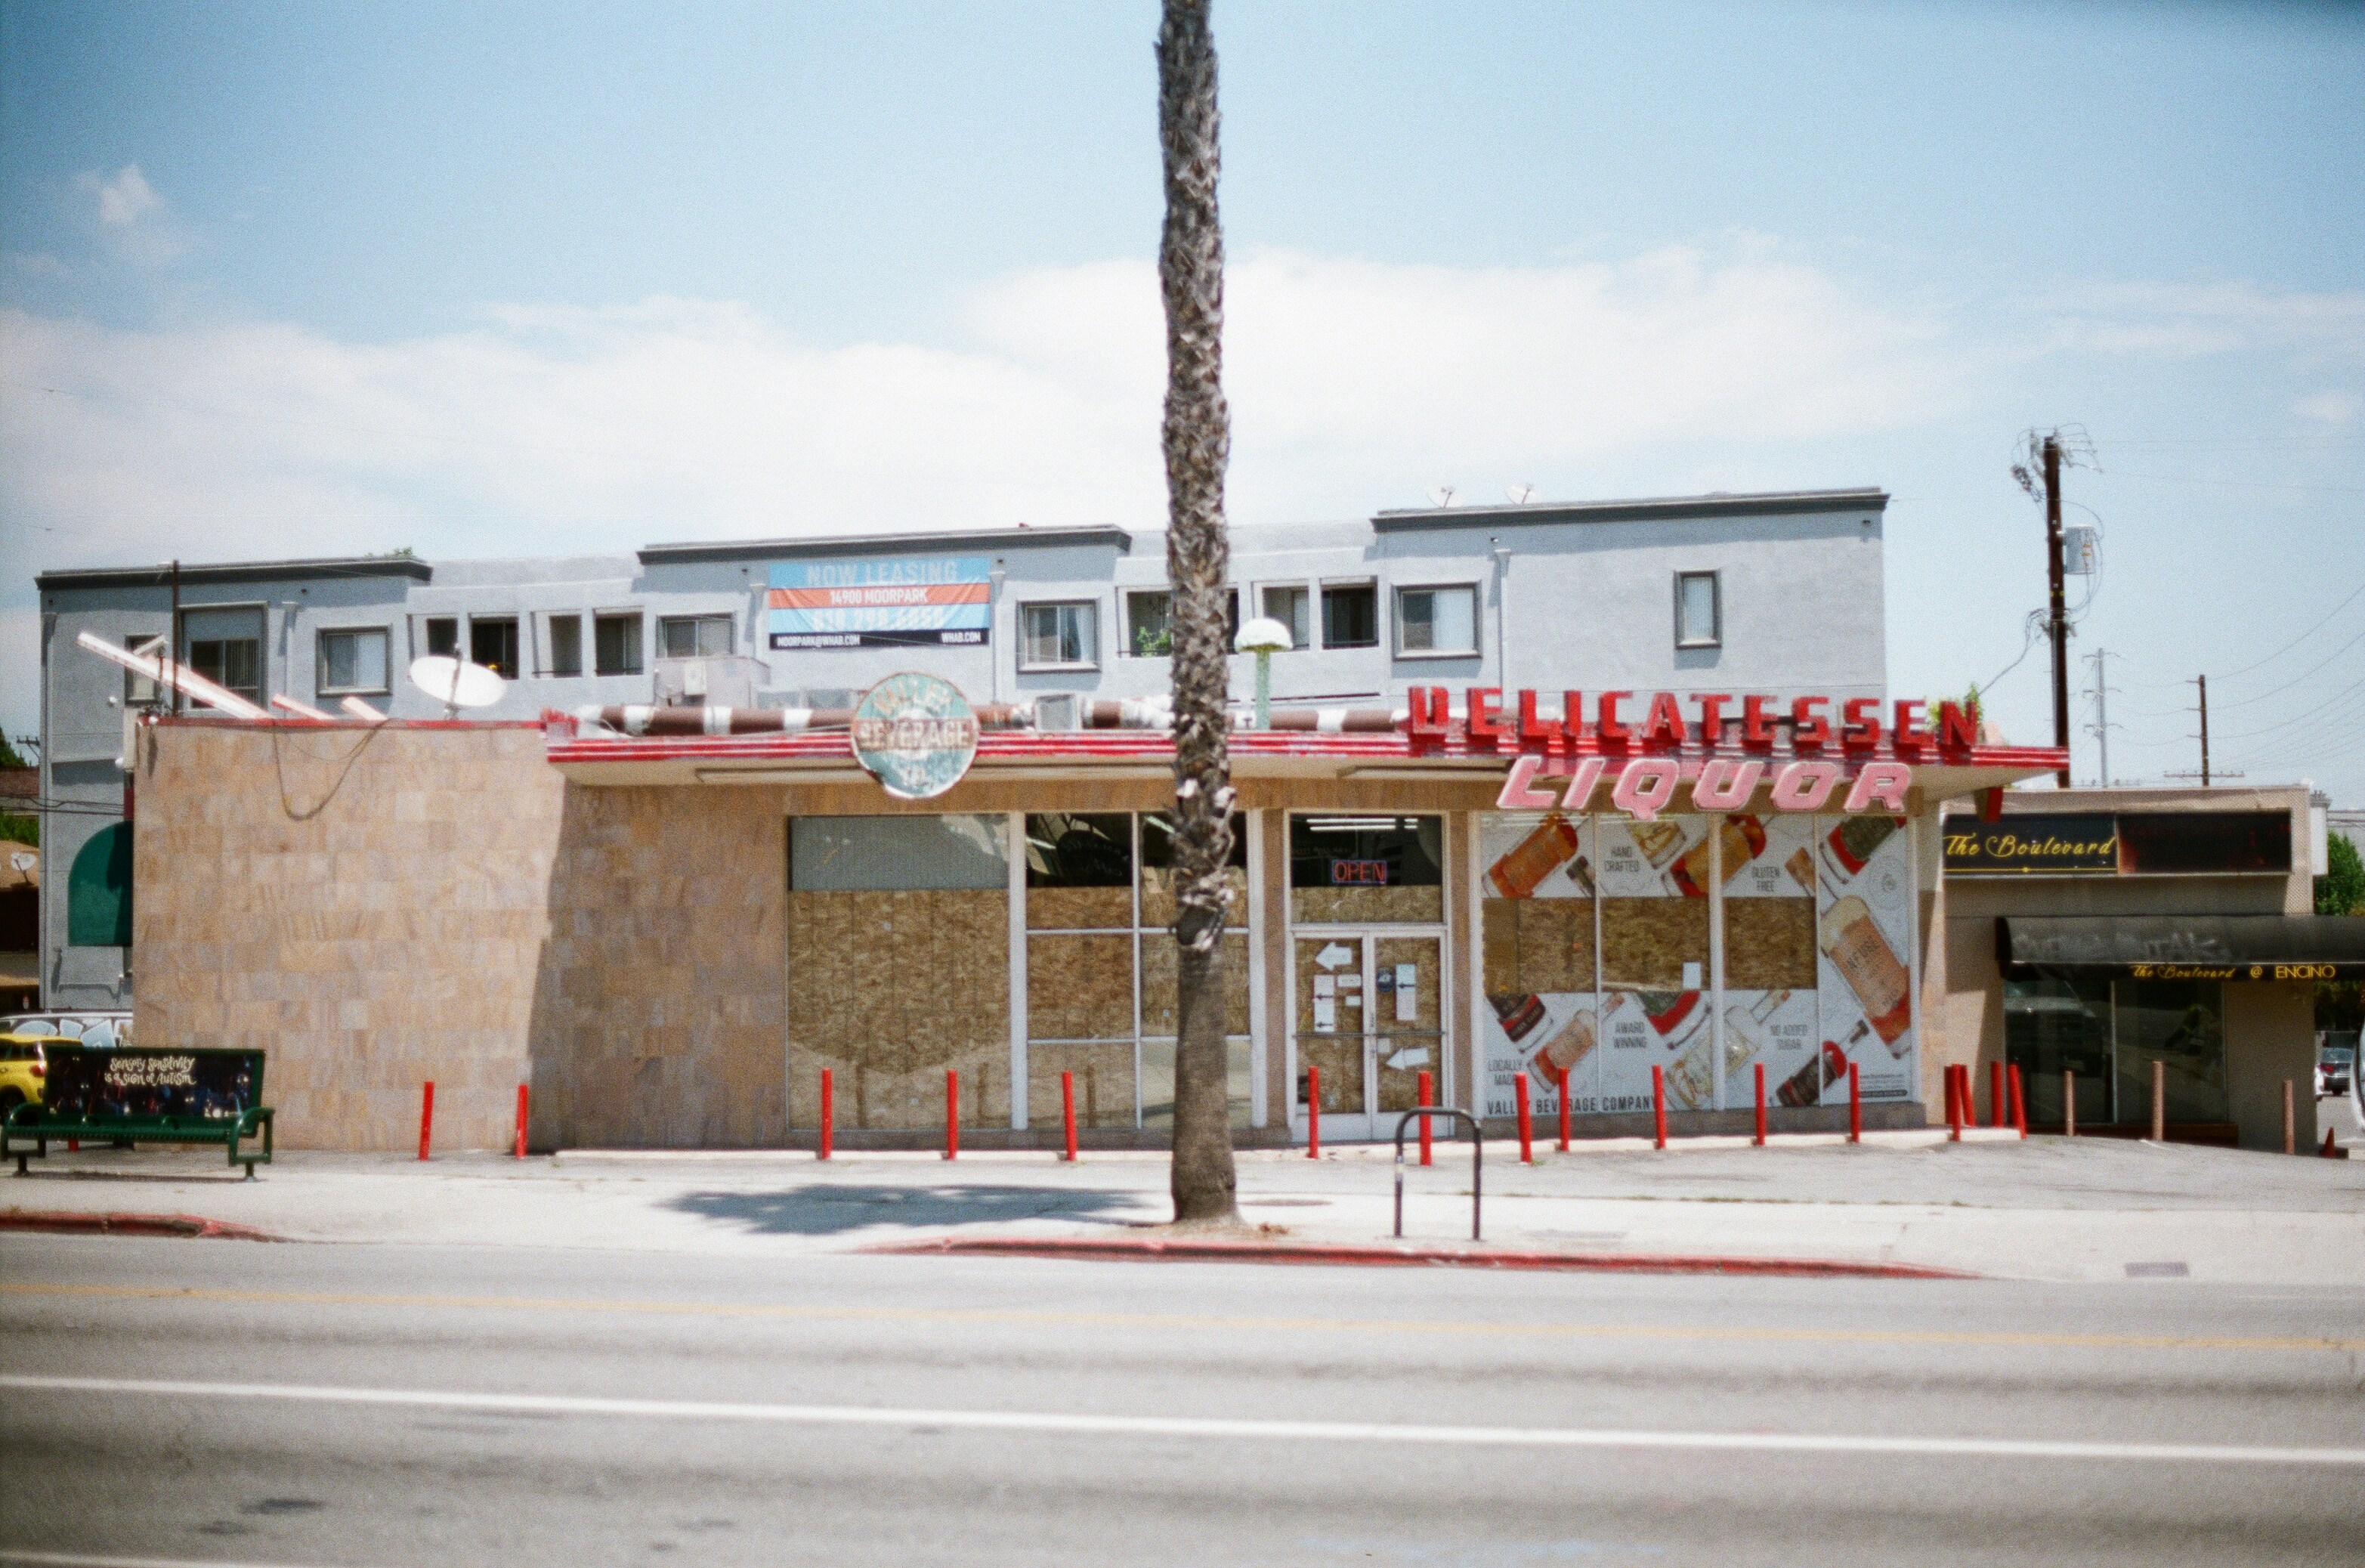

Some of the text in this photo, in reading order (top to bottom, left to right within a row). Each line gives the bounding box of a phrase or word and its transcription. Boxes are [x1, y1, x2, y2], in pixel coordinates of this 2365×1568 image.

[806, 561, 957, 587] NOW LEASING
[830, 588, 928, 605] 14900 MOORPARK
[1408, 686, 1980, 747] DELICATESSEN
[1496, 755, 1913, 821] LIQUOR
[1943, 833, 2116, 858] The Boulevard
[1334, 861, 1386, 883] OPEN
[1604, 860, 1640, 873] CRAFTED
[1757, 880, 1775, 892] FREE
[2132, 963, 2337, 980] The Boulevard @ ENCINO
[1615, 1022, 1646, 1034] AWARD
[1488, 1059, 1523, 1072] LOCALLY
[1487, 1099, 1530, 1115] VALL
[1536, 1096, 1596, 1112] BEVRAGE
